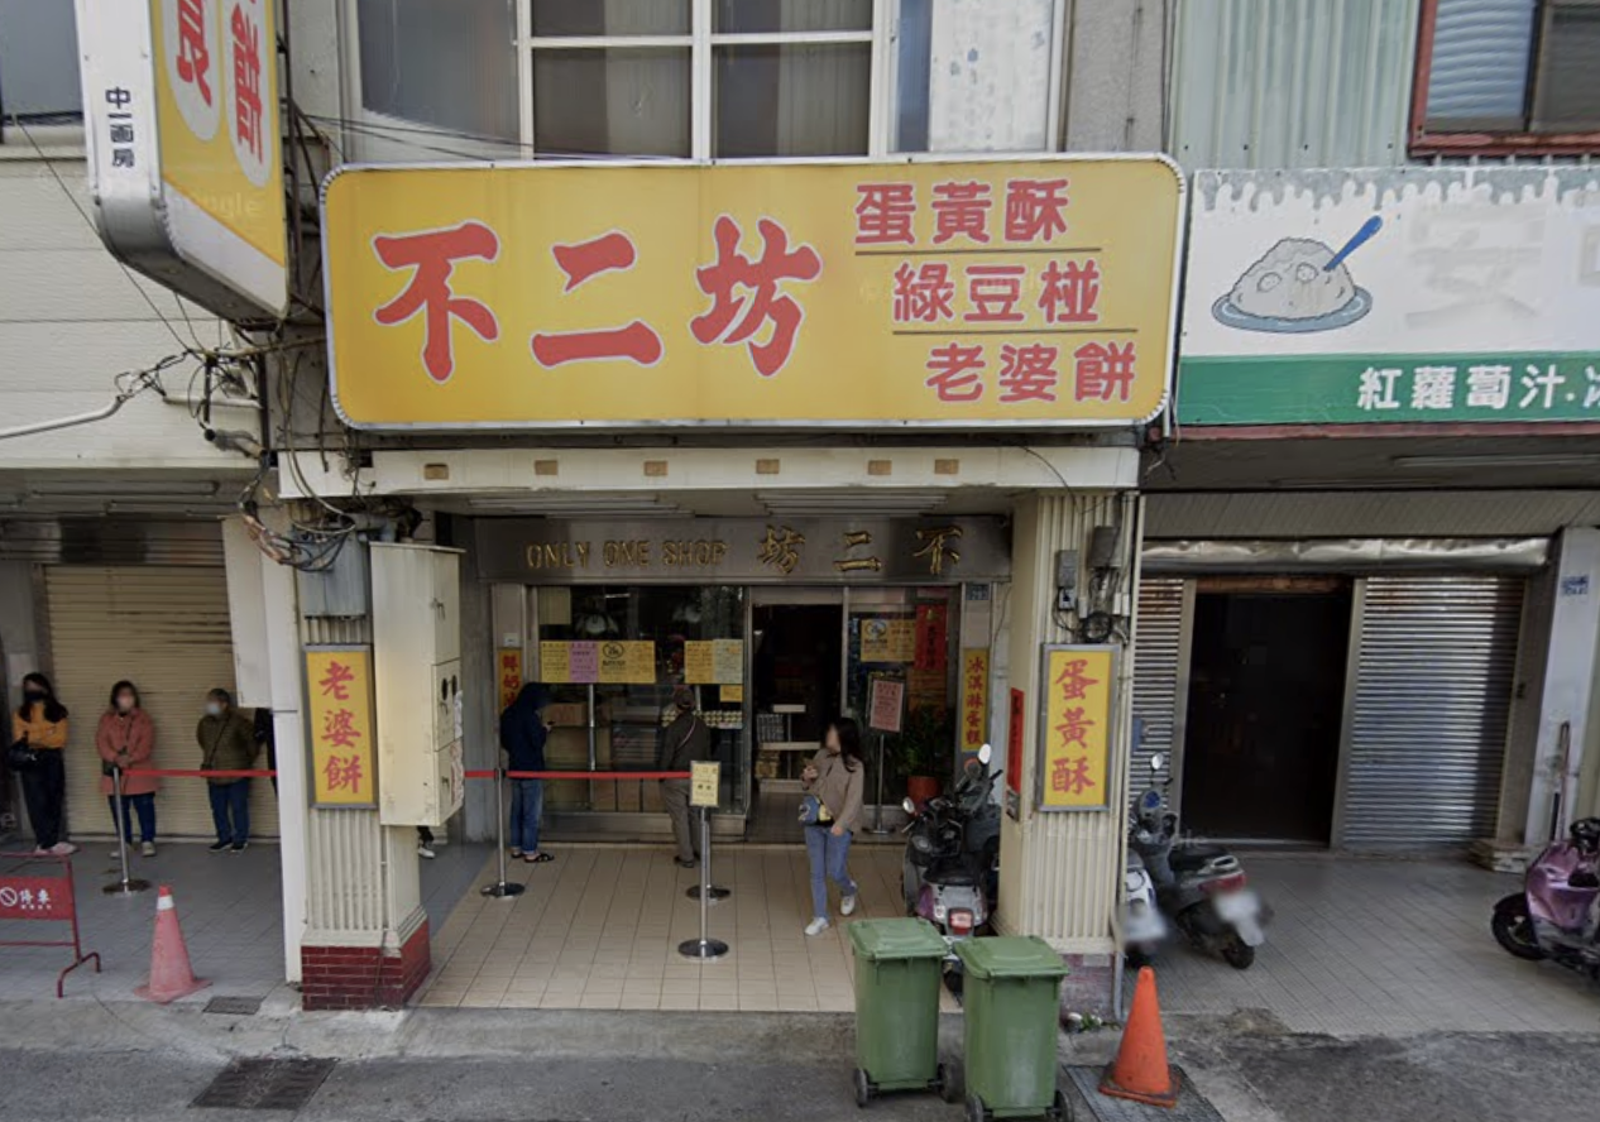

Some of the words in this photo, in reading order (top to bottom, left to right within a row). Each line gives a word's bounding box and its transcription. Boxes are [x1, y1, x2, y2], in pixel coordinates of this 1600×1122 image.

[854, 178, 1070, 245] 蛋黃酥
[374, 215, 822, 382] 不二坊
[893, 259, 1101, 324] 綠豆椪
[925, 341, 1136, 402] 老婆餅
[525, 541, 590, 569] ONLY
[603, 539, 651, 568] ONE
[661, 539, 729, 567] SHOP
[319, 660, 363, 794] 老婆餅
[1051, 658, 1099, 796] 蛋黃酥
